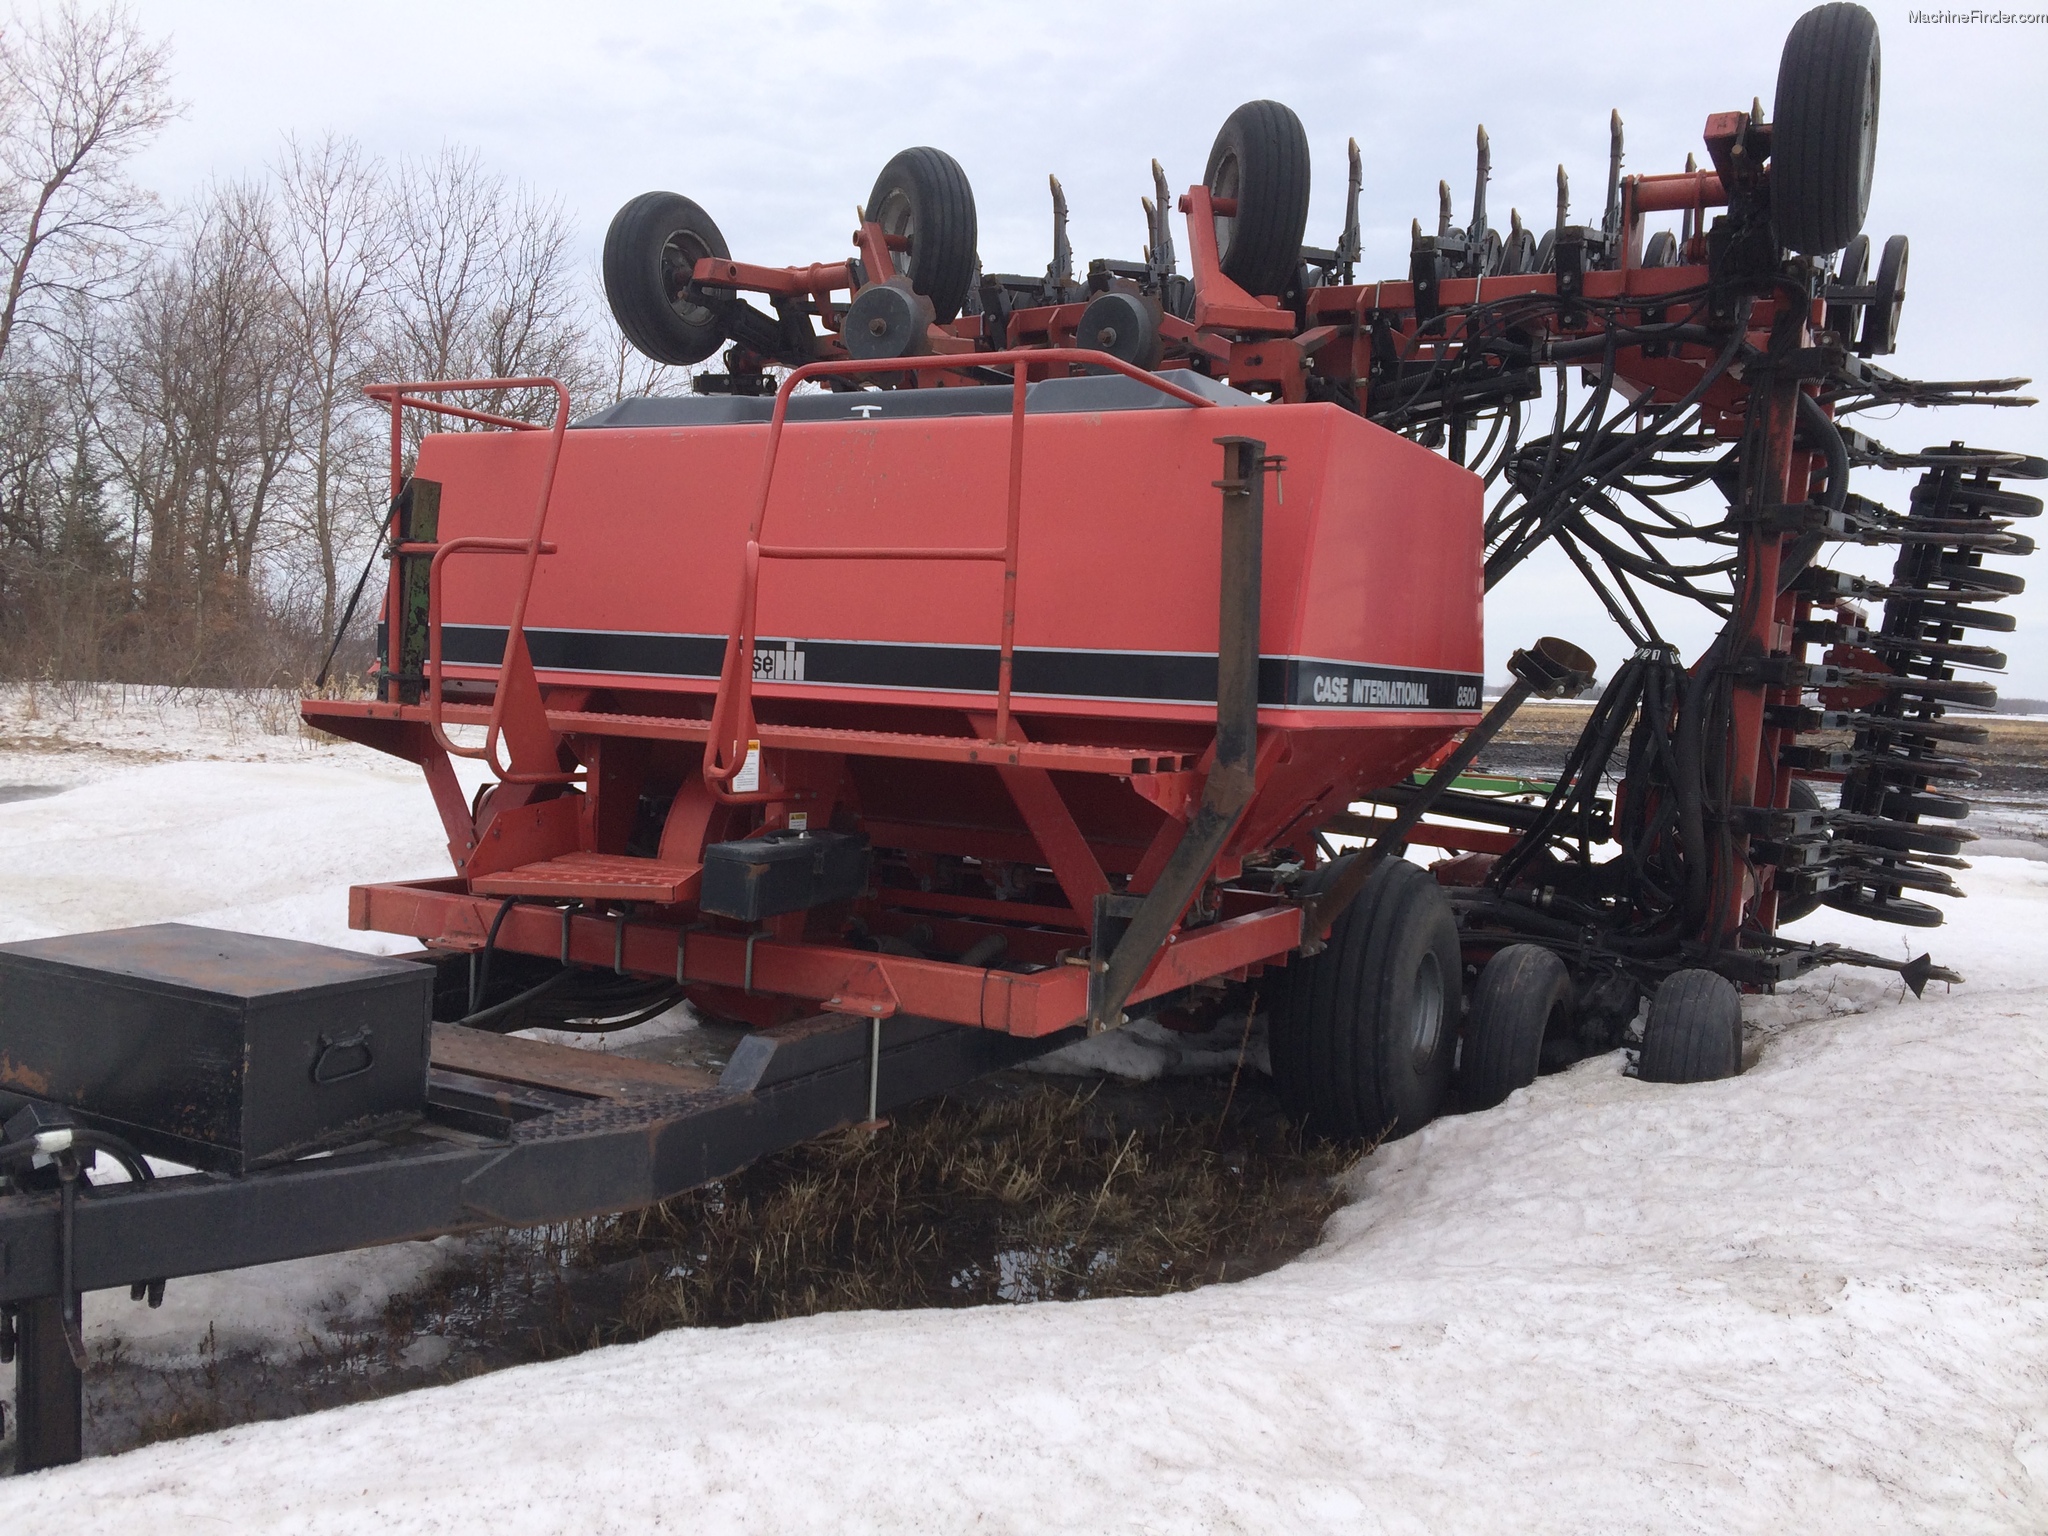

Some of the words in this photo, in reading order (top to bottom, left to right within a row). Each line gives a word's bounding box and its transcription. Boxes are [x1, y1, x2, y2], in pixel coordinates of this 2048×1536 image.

[1313, 675, 1349, 703] CASE
[1352, 678, 1429, 706] INTERNATIONAL
[1456, 686, 1477, 707] 8500
